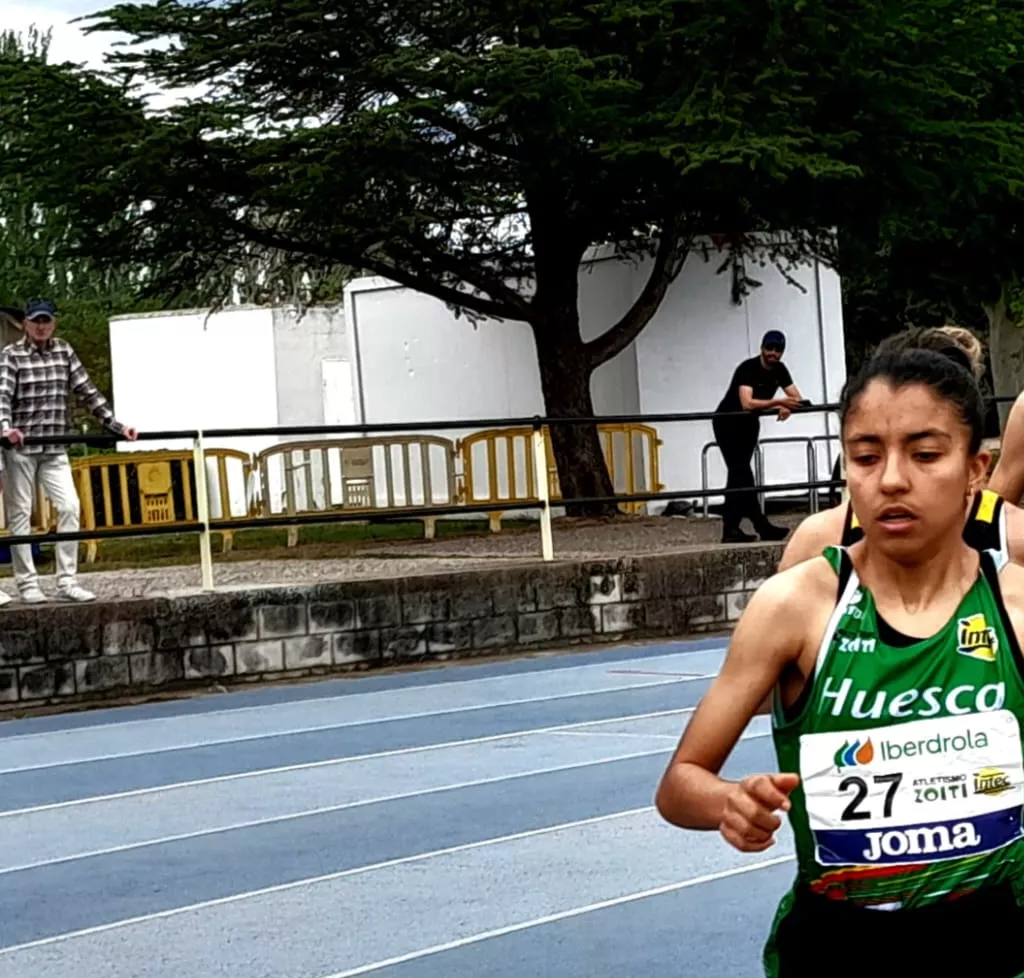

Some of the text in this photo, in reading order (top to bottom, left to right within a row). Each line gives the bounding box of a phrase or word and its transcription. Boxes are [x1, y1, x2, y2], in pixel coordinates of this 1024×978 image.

[820, 677, 1006, 719] Huesca
[880, 729, 989, 761] Iberdrola
[912, 774, 967, 786] ATLETISMO
[913, 783, 968, 803] ZOITI
[837, 772, 904, 822] 27
